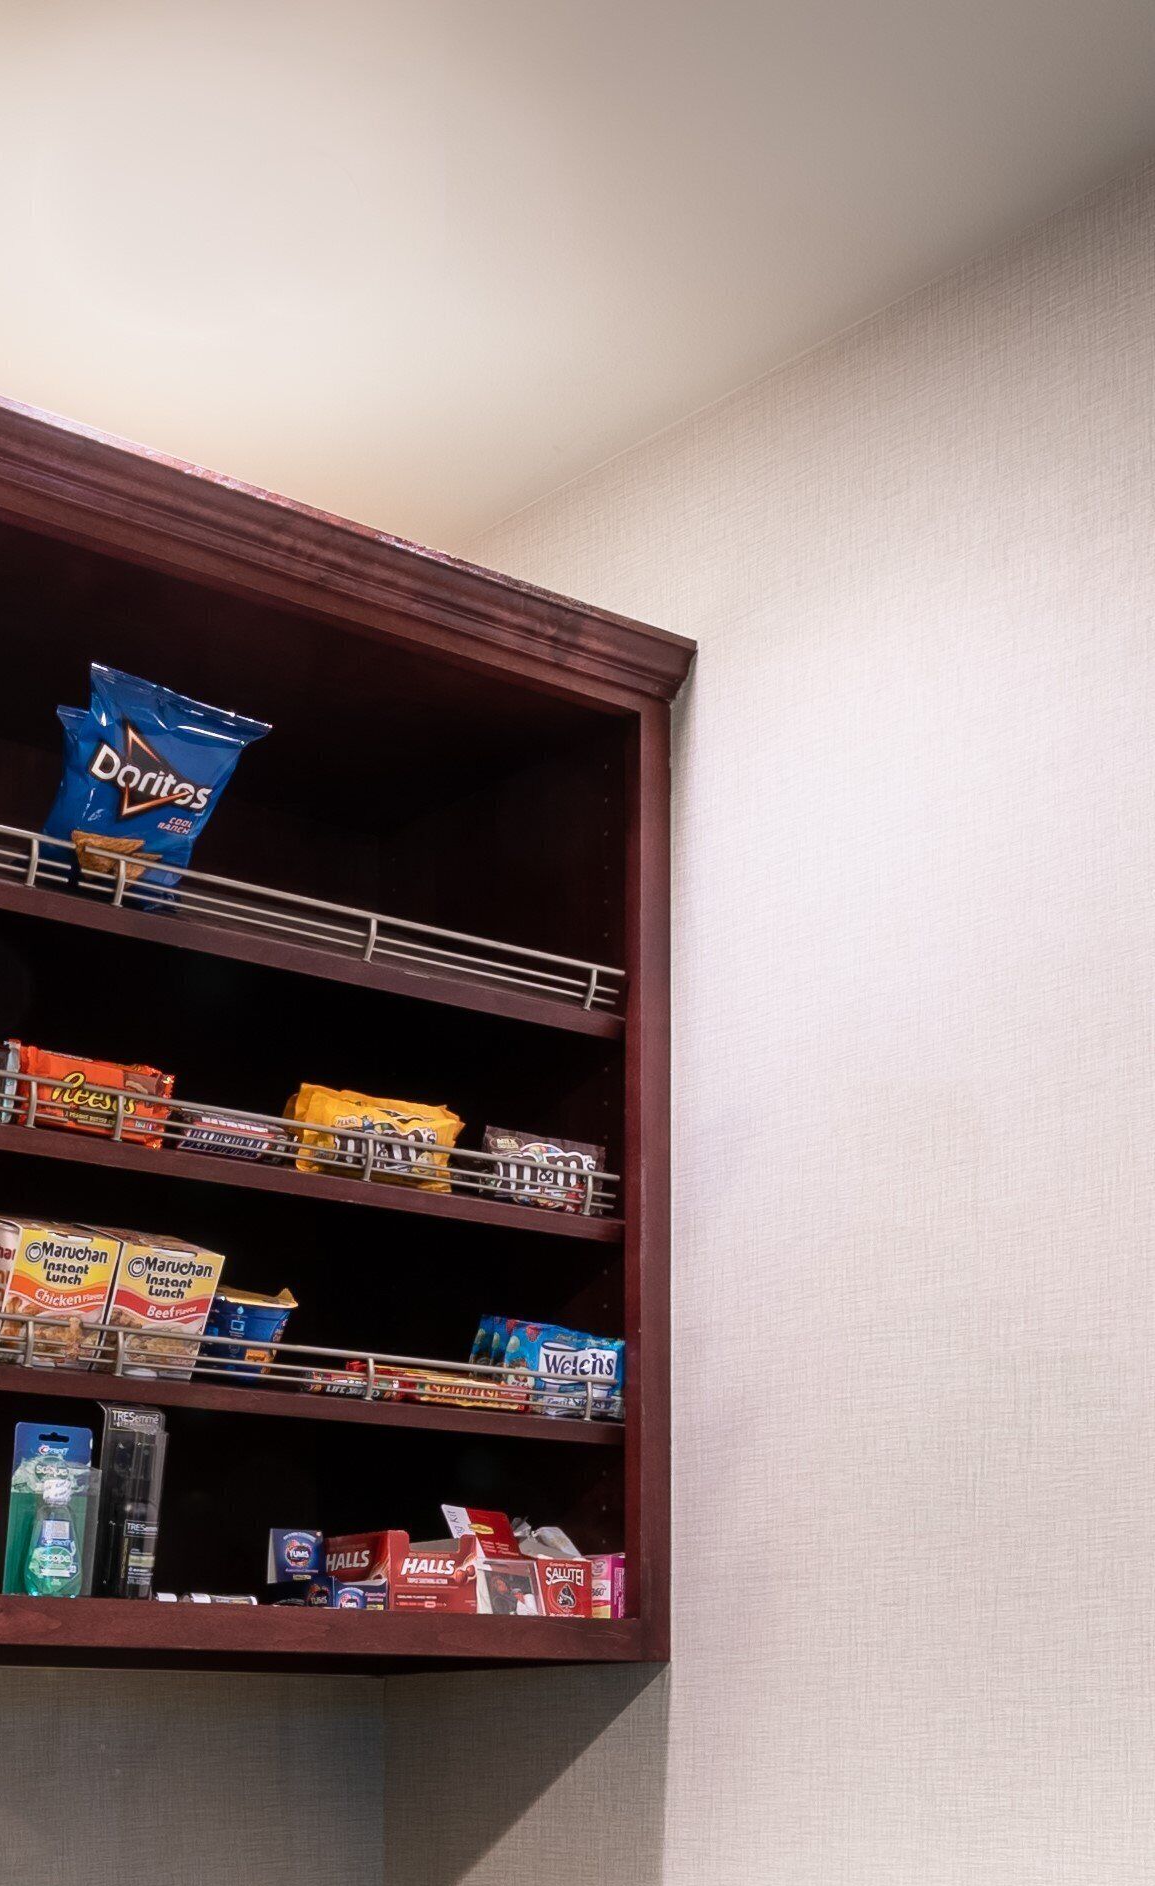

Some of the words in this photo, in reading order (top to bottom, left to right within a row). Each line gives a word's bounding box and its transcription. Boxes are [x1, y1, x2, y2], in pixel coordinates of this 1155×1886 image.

[91, 744, 213, 811] Doritos
[156, 822, 193, 836] RANCH
[169, 816, 193, 829] COOL
[43, 1241, 109, 1265] Maruchan
[43, 1258, 89, 1276] Instant
[144, 1256, 214, 1279] Maruchan
[46, 1271, 82, 1286] Lunch
[145, 1272, 194, 1289] Instant
[34, 1288, 83, 1308] Chicken
[148, 1285, 186, 1300] Lunch
[147, 1305, 176, 1320] Beef
[543, 1352, 615, 1377] Welch's
[325, 1549, 371, 1573] HALLS
[400, 1557, 456, 1576] HALLS
